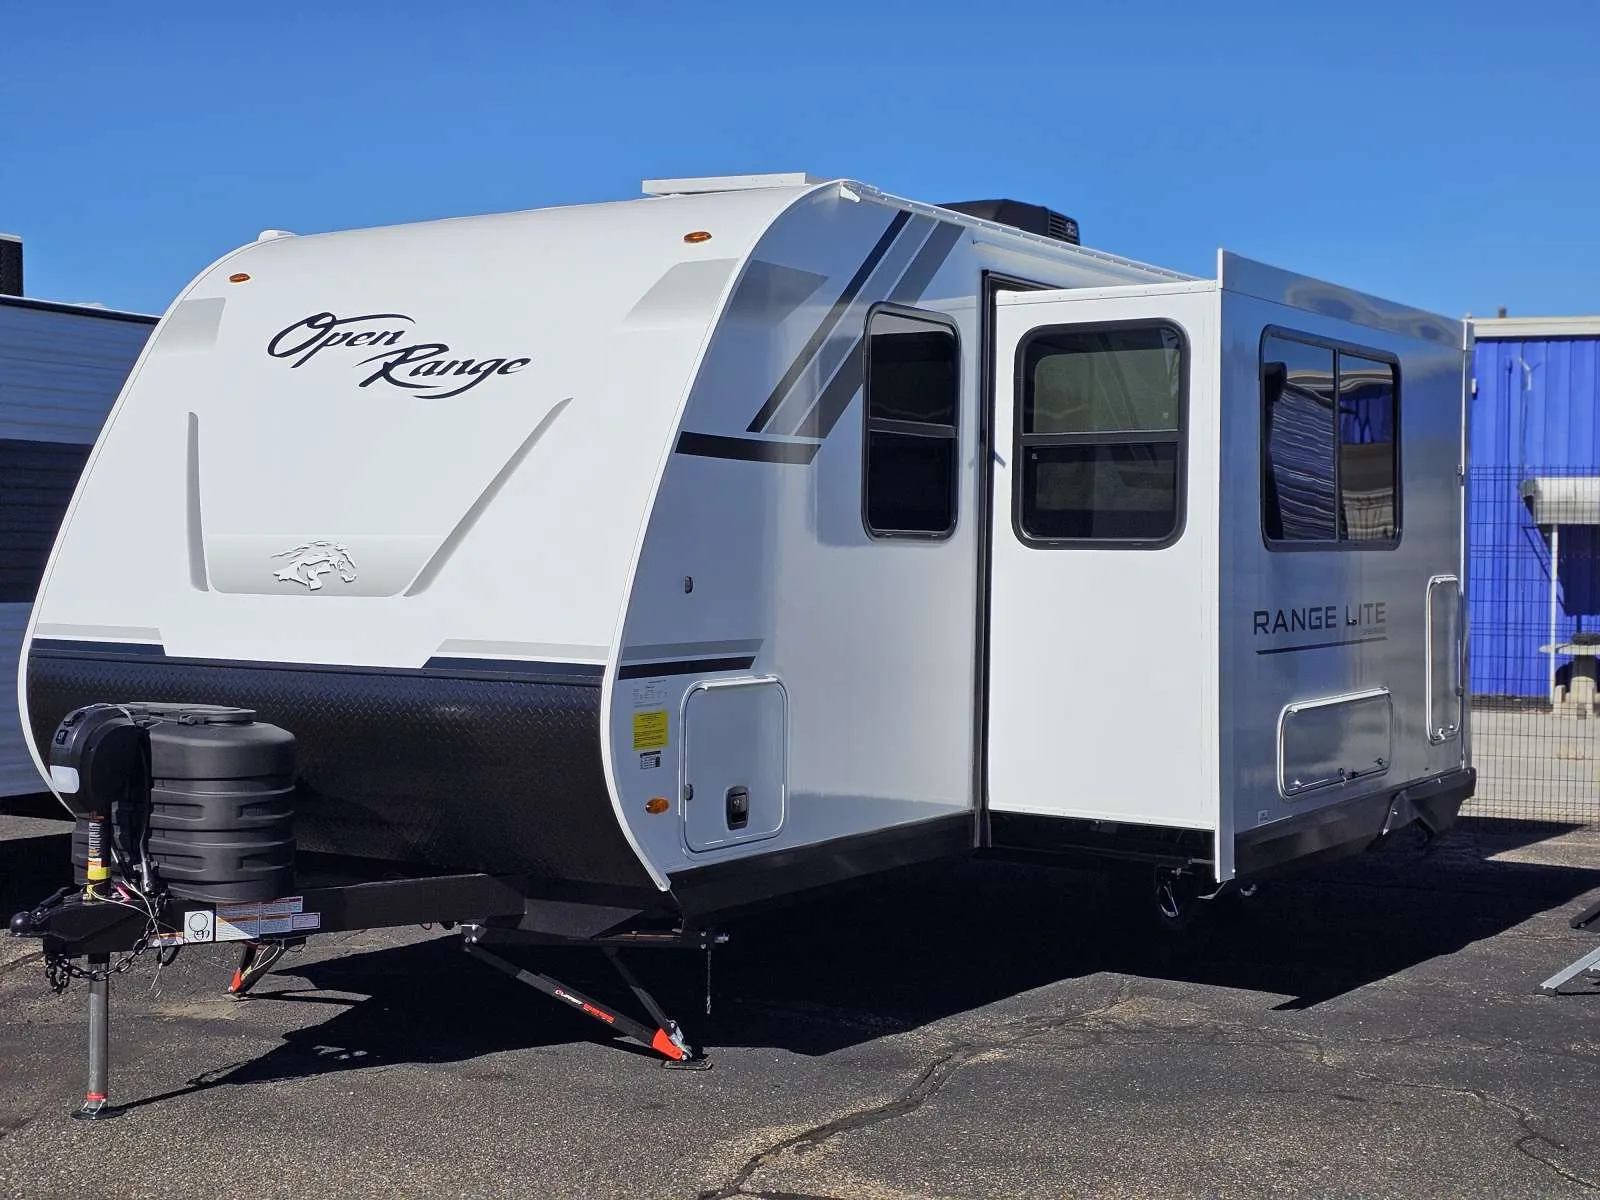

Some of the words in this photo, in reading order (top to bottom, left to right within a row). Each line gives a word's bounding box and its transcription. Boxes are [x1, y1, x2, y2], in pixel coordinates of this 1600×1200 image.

[267, 311, 416, 368] Open
[352, 343, 532, 399] Range
[1253, 606, 1337, 635] RANGE
[1345, 602, 1387, 626] LITE
